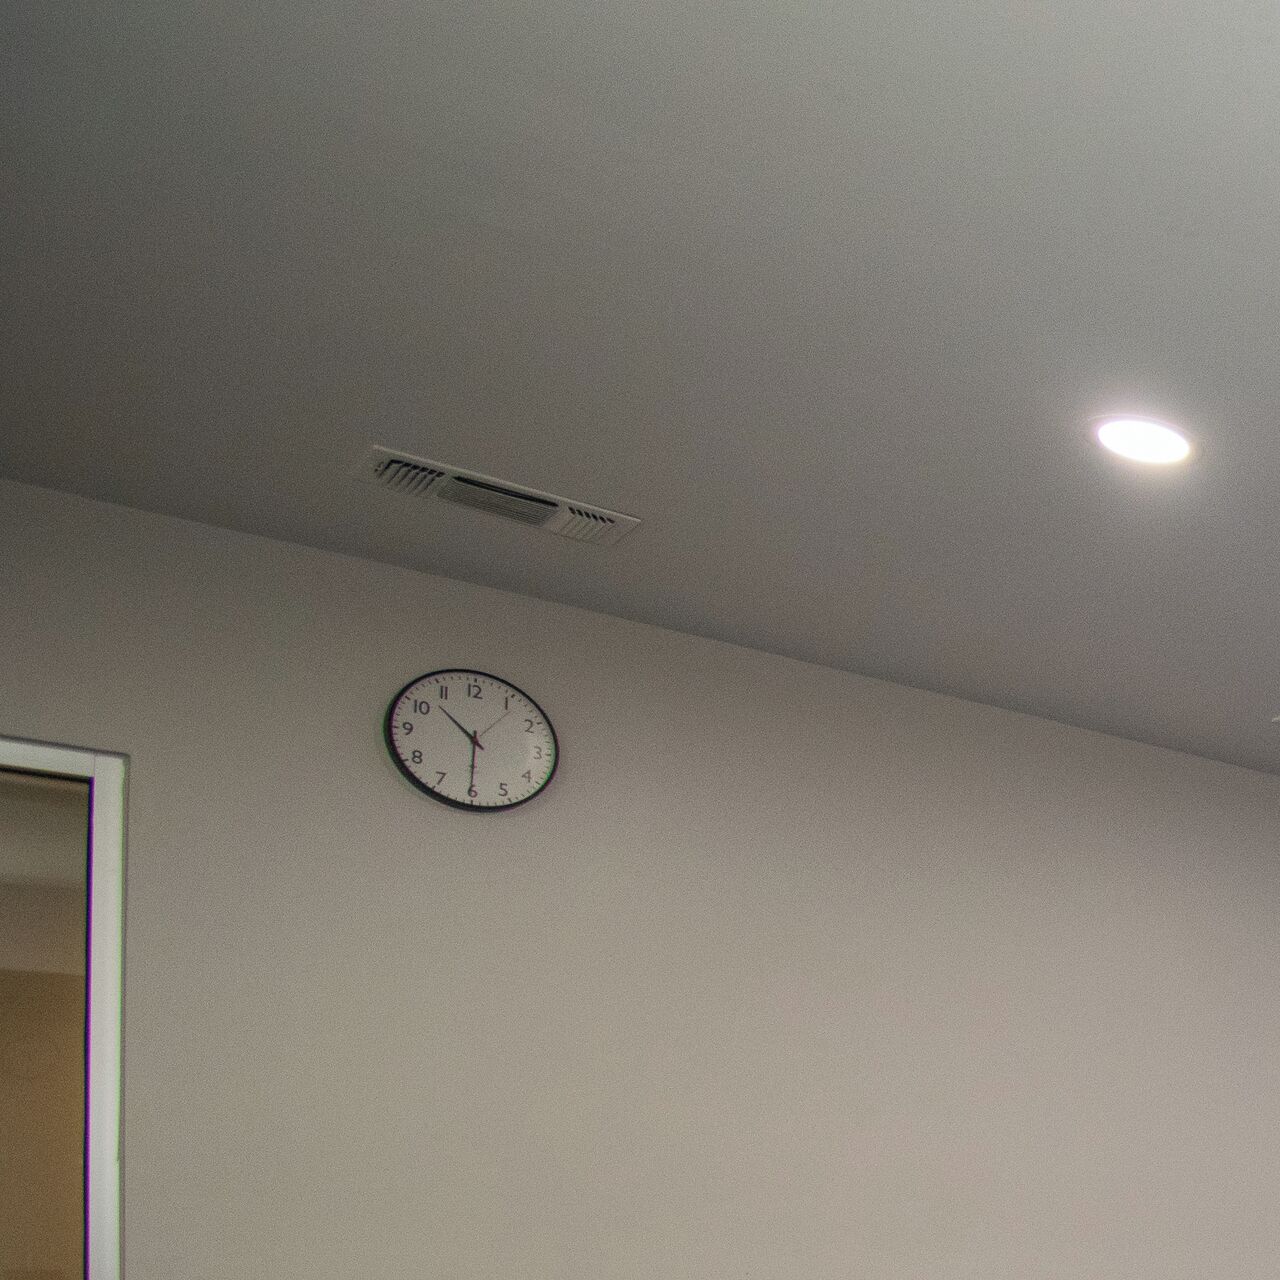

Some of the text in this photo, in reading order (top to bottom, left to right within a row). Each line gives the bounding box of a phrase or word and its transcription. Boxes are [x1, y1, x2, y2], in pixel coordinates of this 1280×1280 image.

[440, 685, 449, 700] 11
[467, 684, 483, 700] 12
[414, 699, 430, 715] 10
[503, 697, 509, 711] 1
[402, 722, 414, 735] 9
[524, 719, 535, 734] 2
[411, 750, 423, 764] 8
[533, 746, 543, 760] 3
[435, 771, 446, 785] 7
[521, 769, 532, 783] 4
[468, 783, 478, 798] 6
[498, 782, 509, 797] 5
